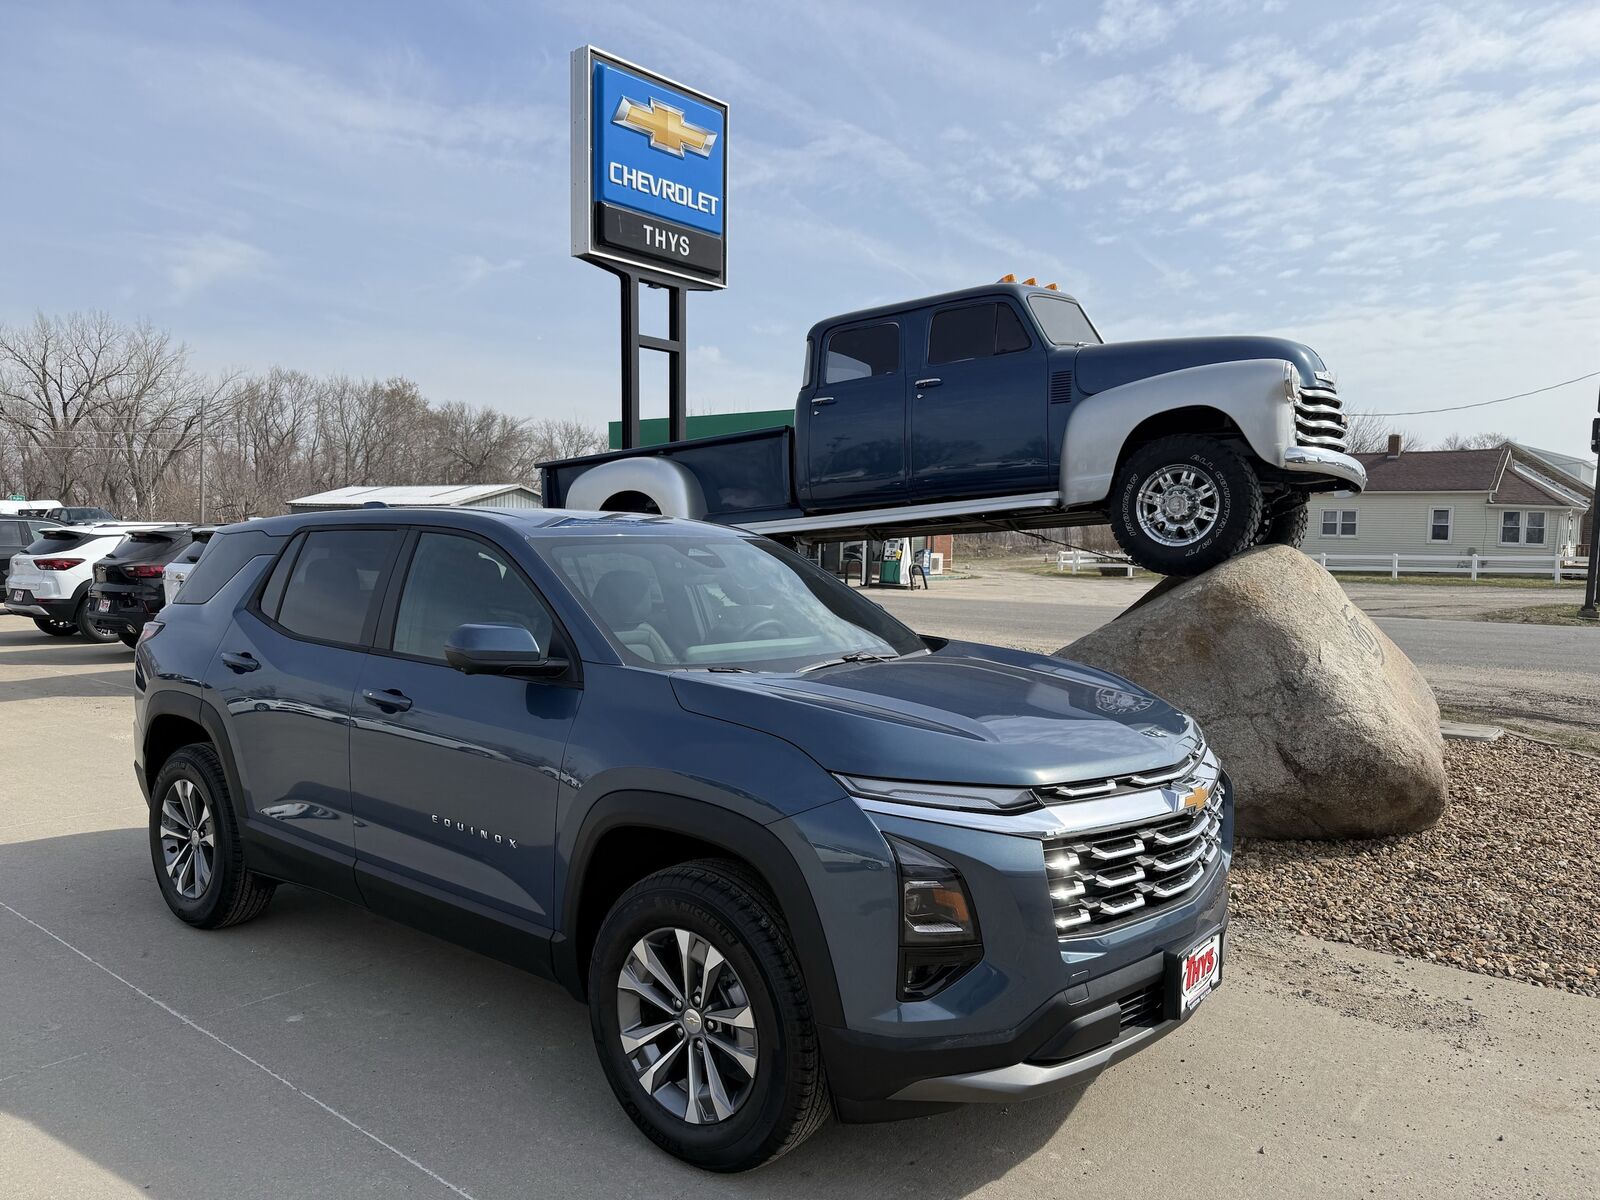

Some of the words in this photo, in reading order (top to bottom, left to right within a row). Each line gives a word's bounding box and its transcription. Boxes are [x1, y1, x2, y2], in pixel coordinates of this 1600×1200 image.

[609, 161, 718, 215] CHEVROLET
[643, 224, 690, 256] THYS
[1190, 453, 1214, 471] ALL
[432, 814, 517, 848] EQUINOX
[679, 902, 738, 944] MICHELIN
[1186, 947, 1214, 991] THYS
